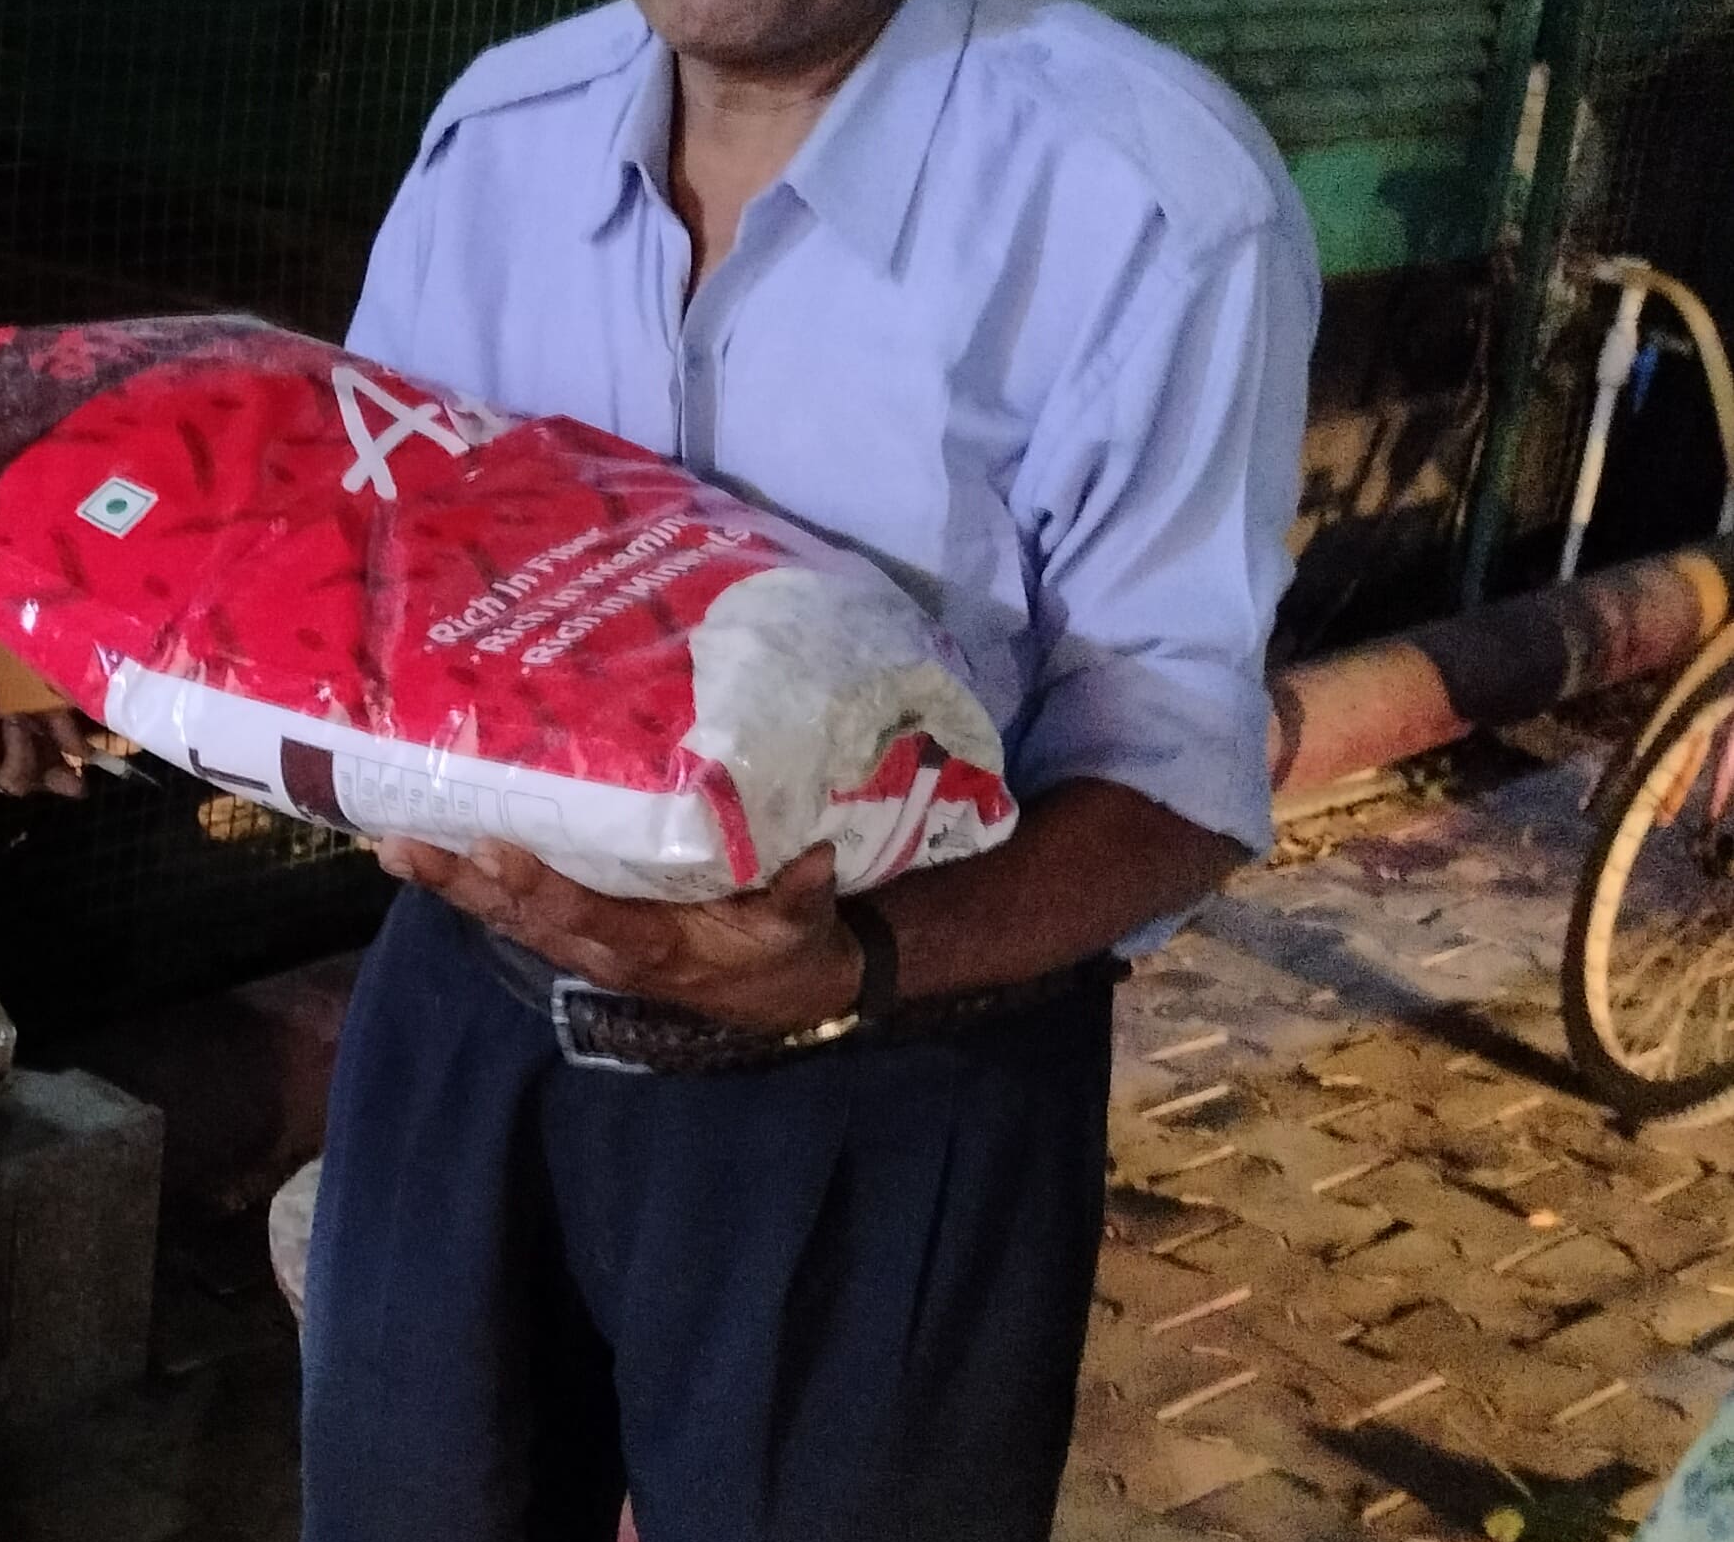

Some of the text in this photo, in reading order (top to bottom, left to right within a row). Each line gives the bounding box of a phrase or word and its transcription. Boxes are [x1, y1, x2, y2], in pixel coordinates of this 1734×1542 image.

[427, 591, 507, 645] Rich
[475, 610, 554, 654] Rich
[521, 614, 602, 666] Rich
